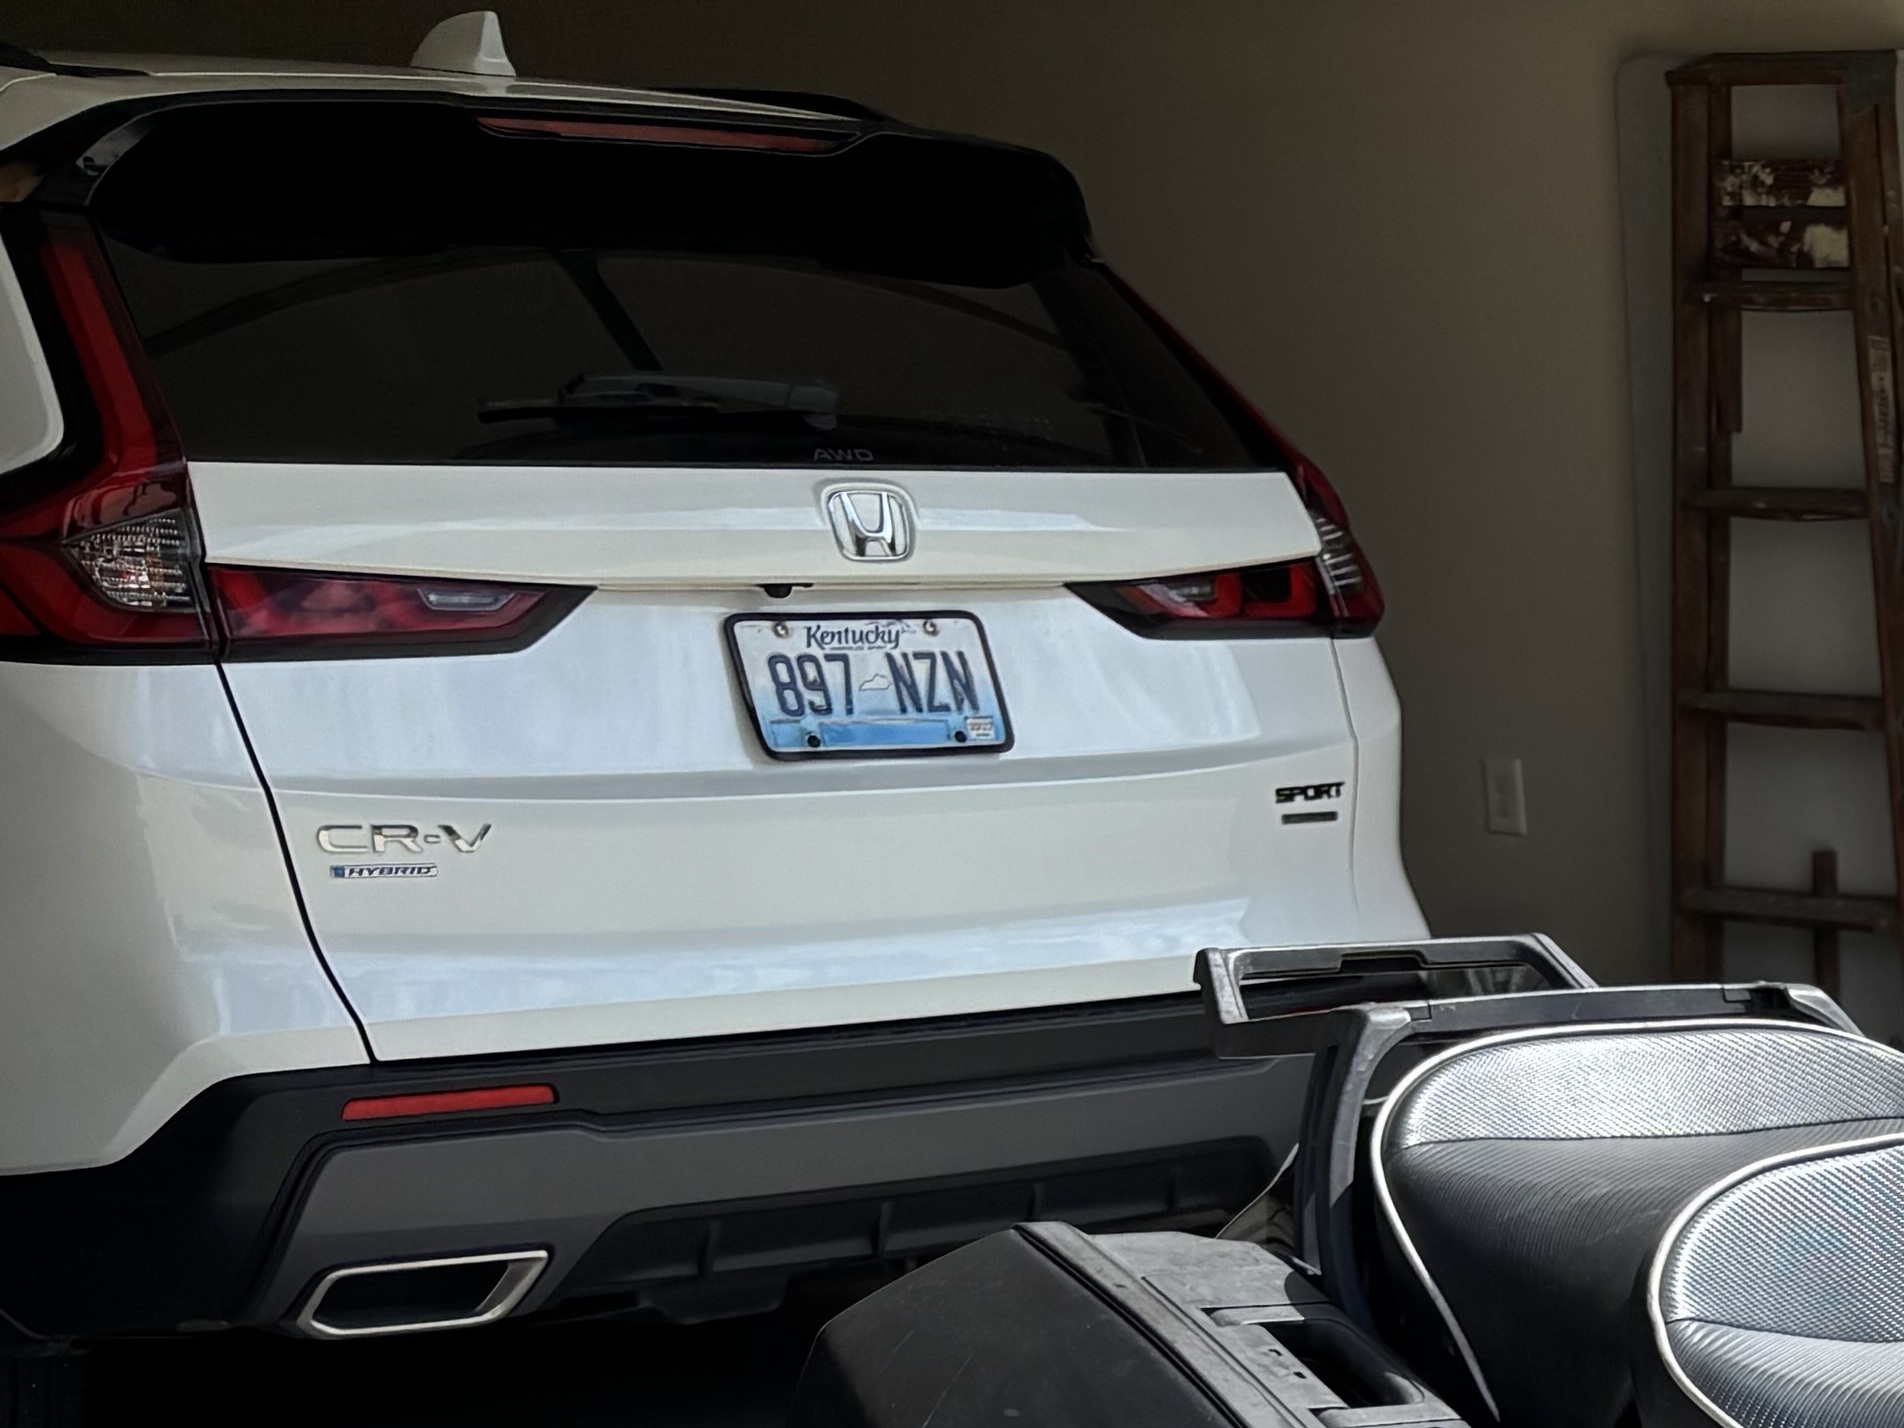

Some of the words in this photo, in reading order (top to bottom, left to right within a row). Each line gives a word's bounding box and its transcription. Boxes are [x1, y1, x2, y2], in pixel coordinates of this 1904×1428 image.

[814, 448, 874, 461] AWD
[804, 625, 900, 650] Kentucky
[767, 653, 855, 717] 897
[885, 650, 980, 714] NZN
[316, 823, 492, 853] CR-V
[348, 865, 432, 877] HYBRID
